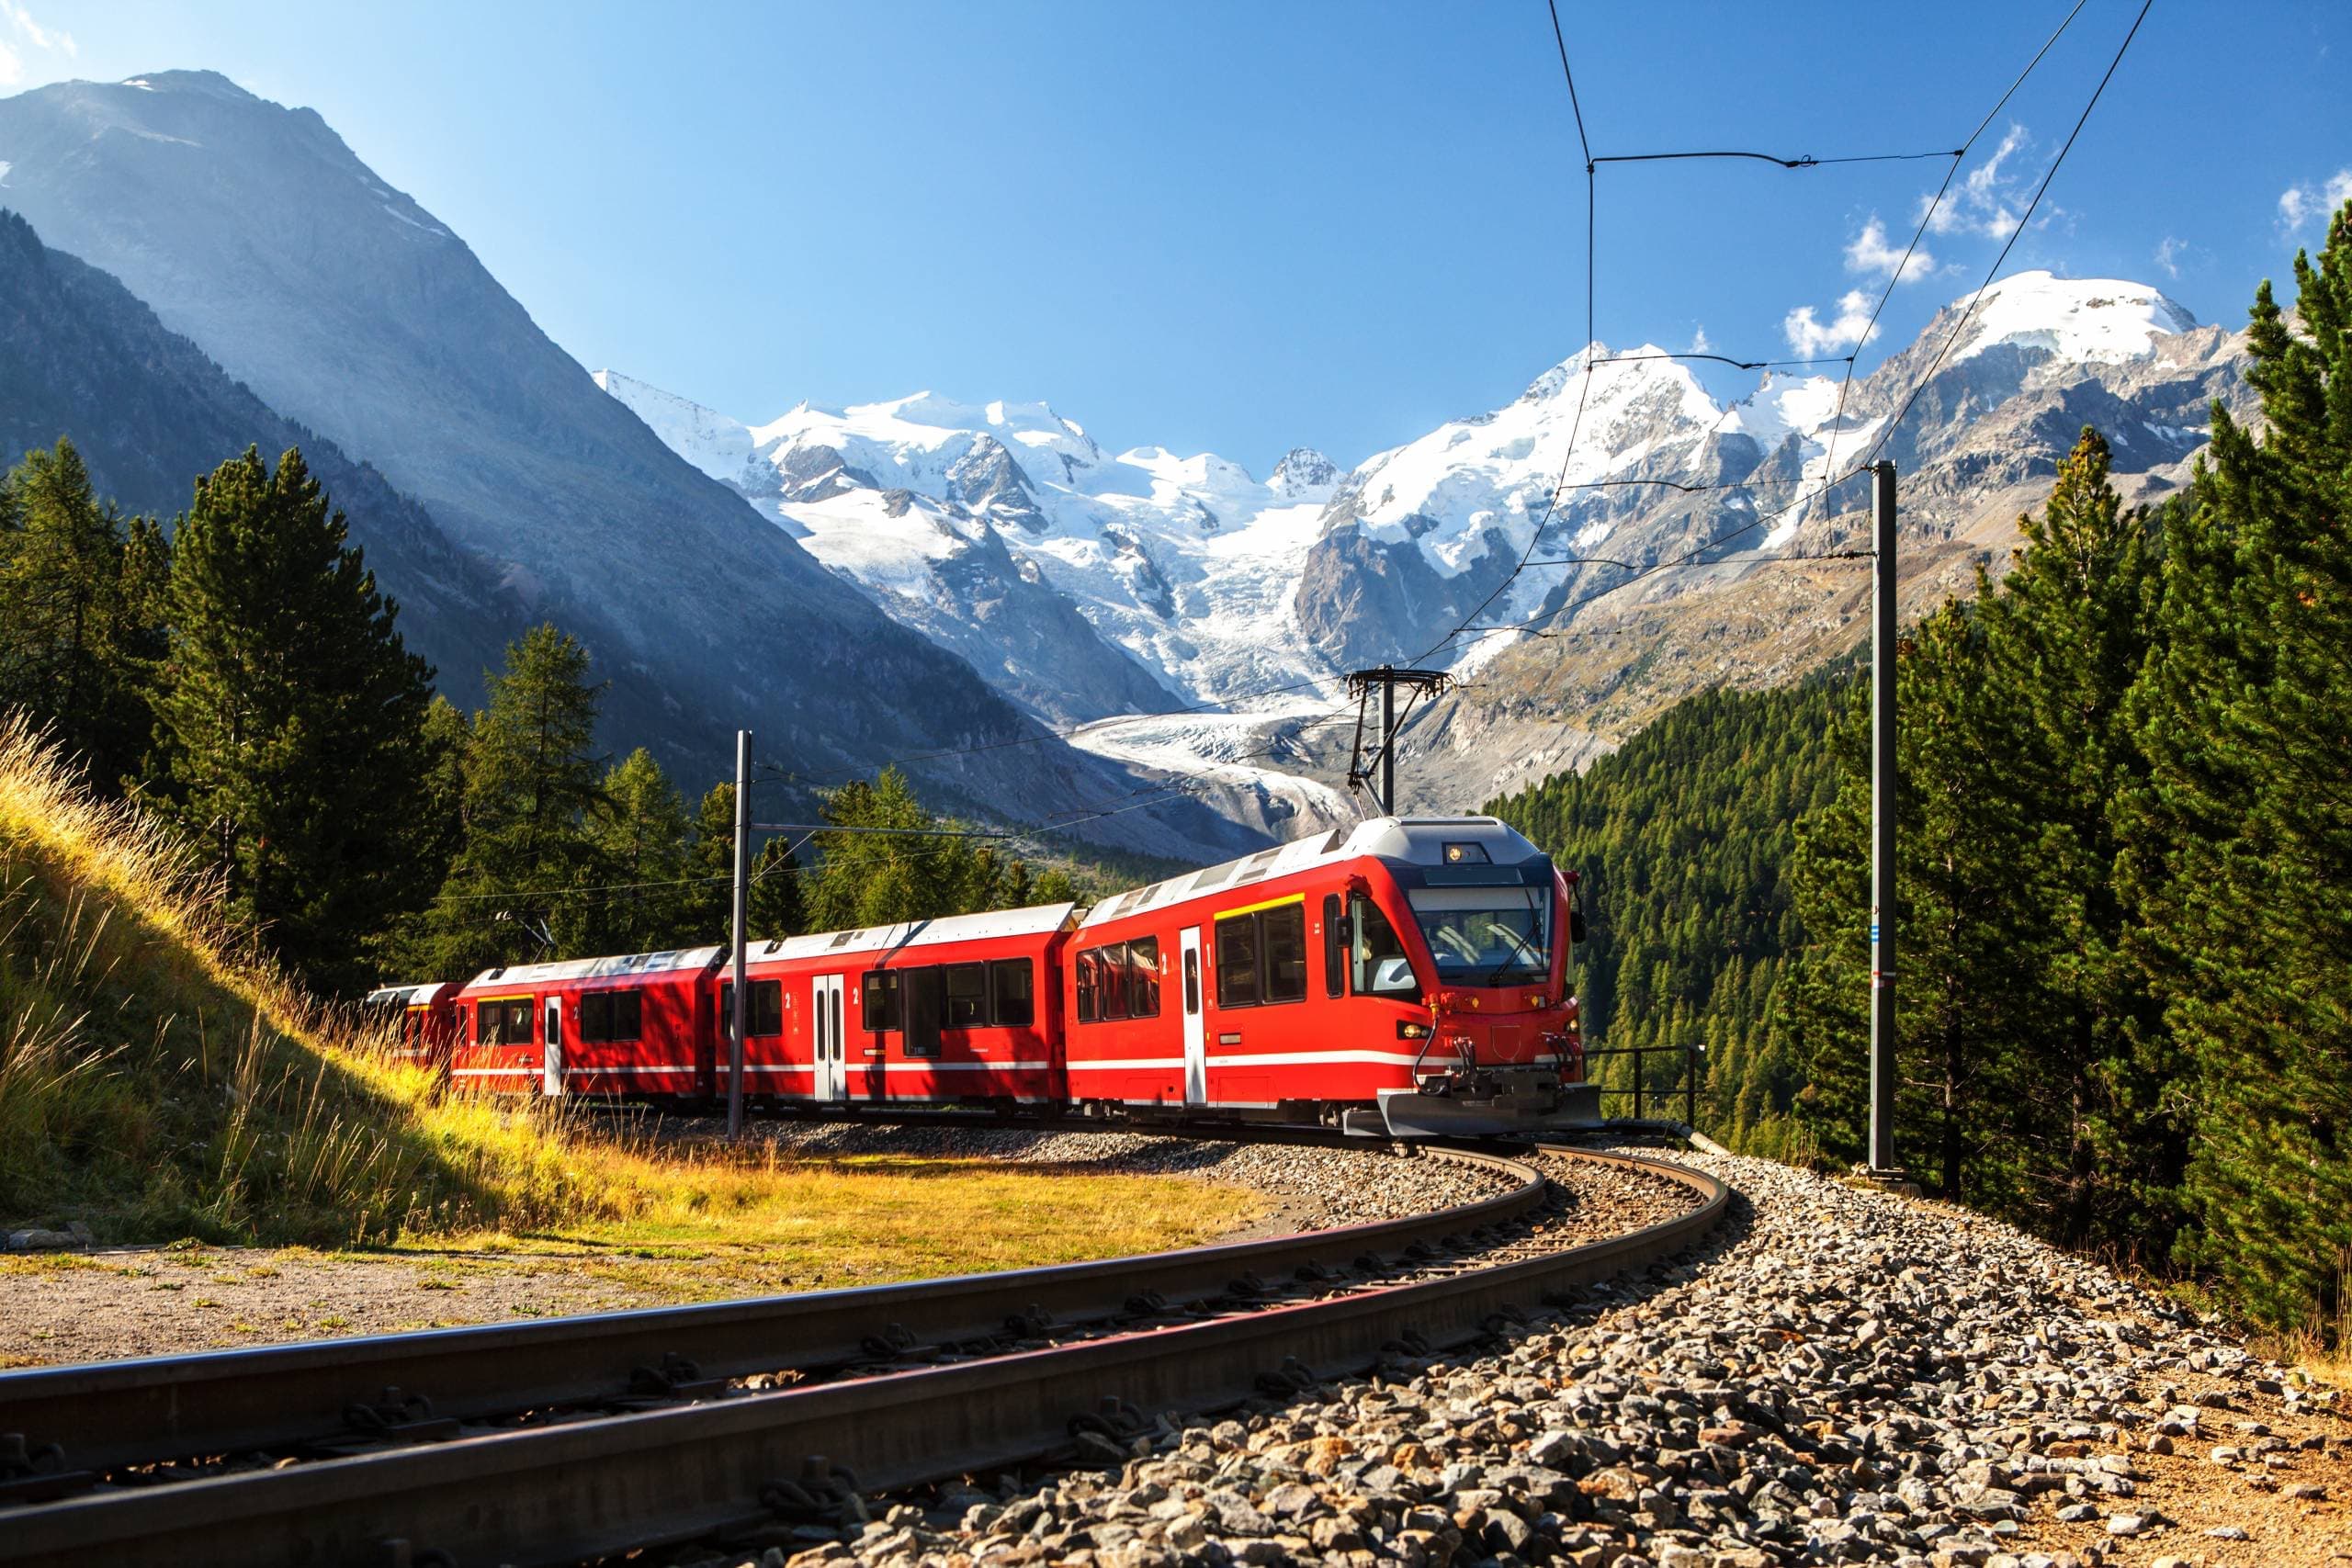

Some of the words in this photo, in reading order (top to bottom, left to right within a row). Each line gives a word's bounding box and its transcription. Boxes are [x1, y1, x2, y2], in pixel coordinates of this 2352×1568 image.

[1206, 943, 1211, 967] 1
[1161, 953, 1168, 976] 2
[785, 992, 791, 1009] 2
[853, 987, 859, 1005] 2
[573, 1006, 579, 1020] 2
